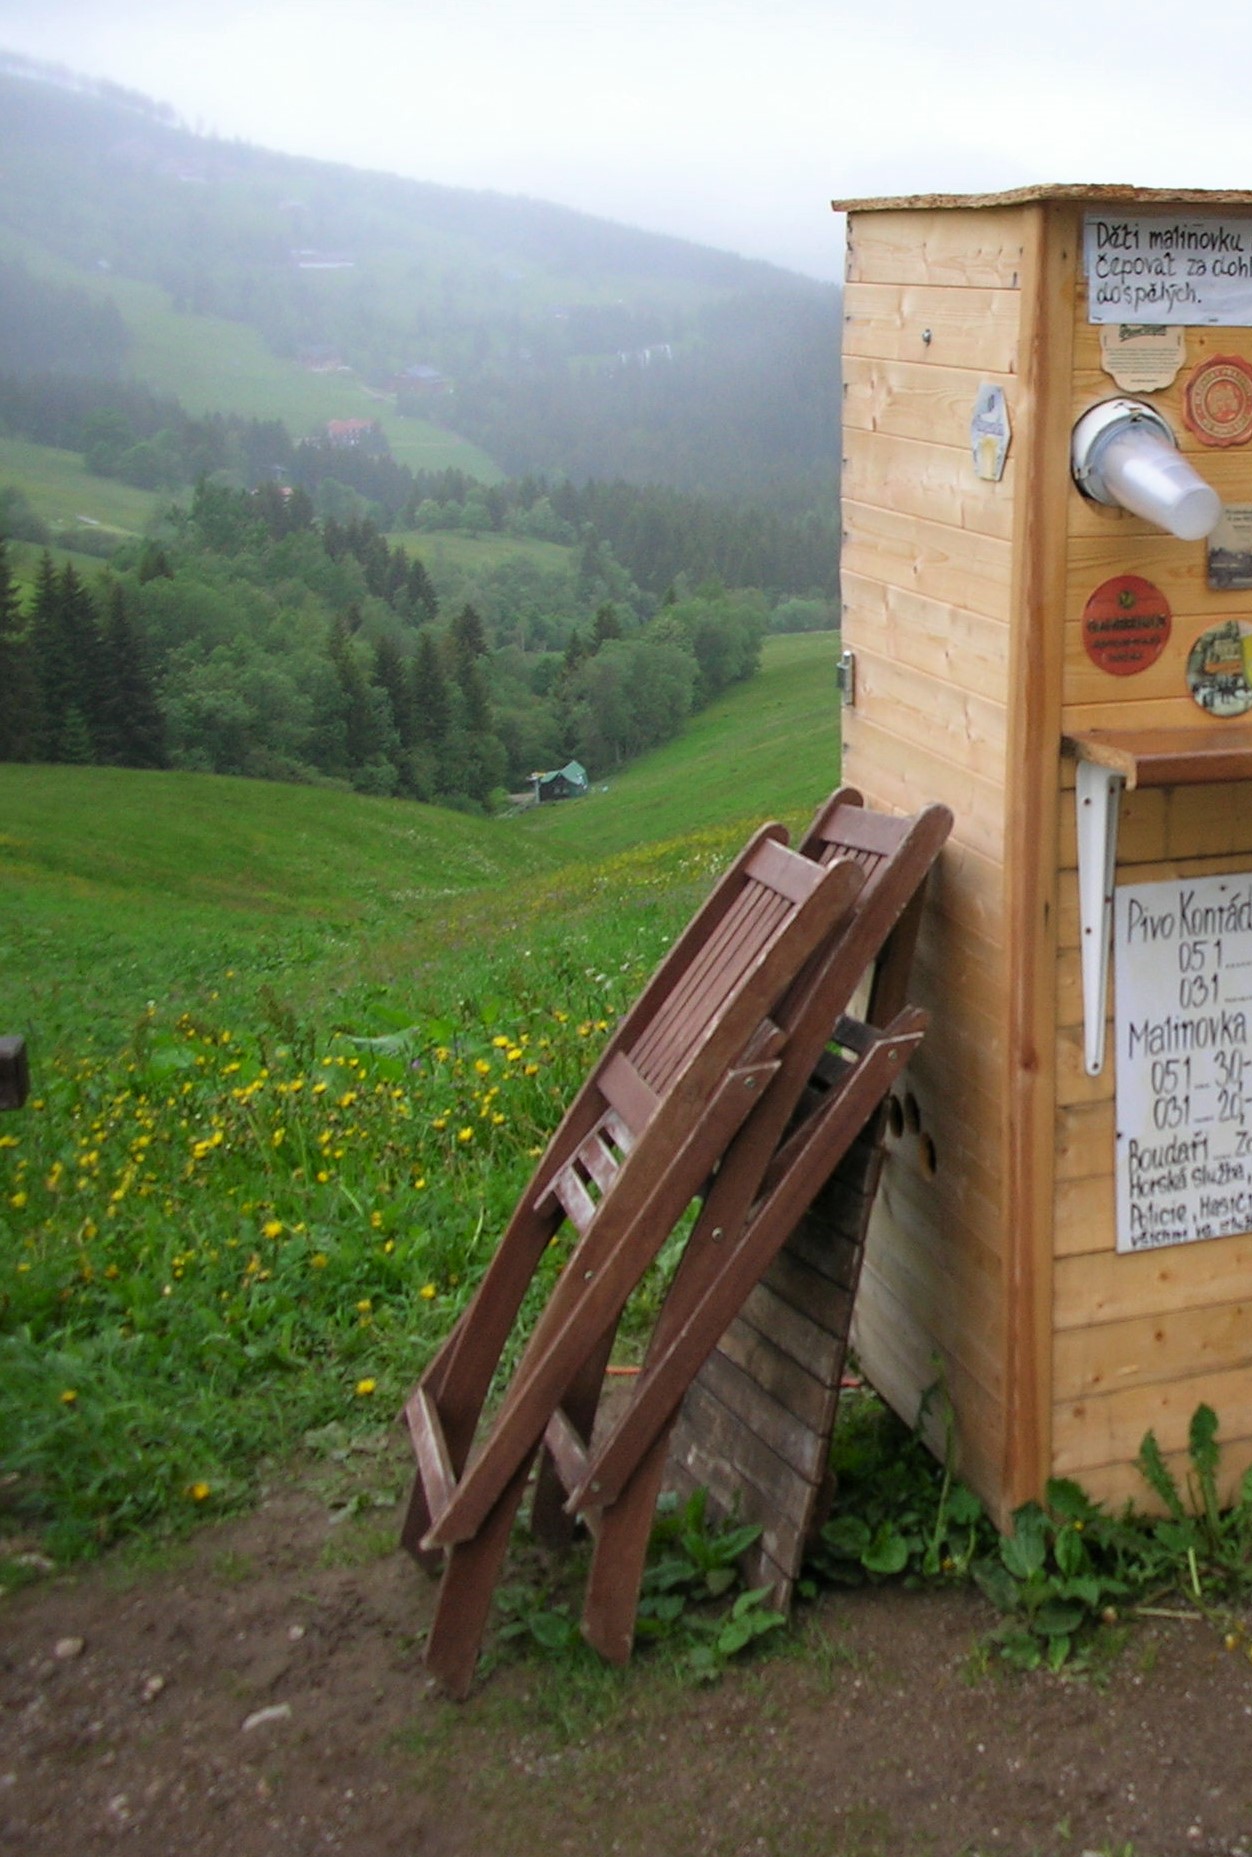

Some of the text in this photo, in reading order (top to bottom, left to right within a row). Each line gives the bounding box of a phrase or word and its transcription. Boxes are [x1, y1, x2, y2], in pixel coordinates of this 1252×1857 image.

[1095, 220, 1139, 251] Děti
[1149, 222, 1244, 253] malinovku
[1186, 257, 1208, 276] za
[1127, 898, 1174, 943] Pivo
[1178, 883, 1252, 939] Konrád
[1128, 1010, 1248, 1060] Malinovka
